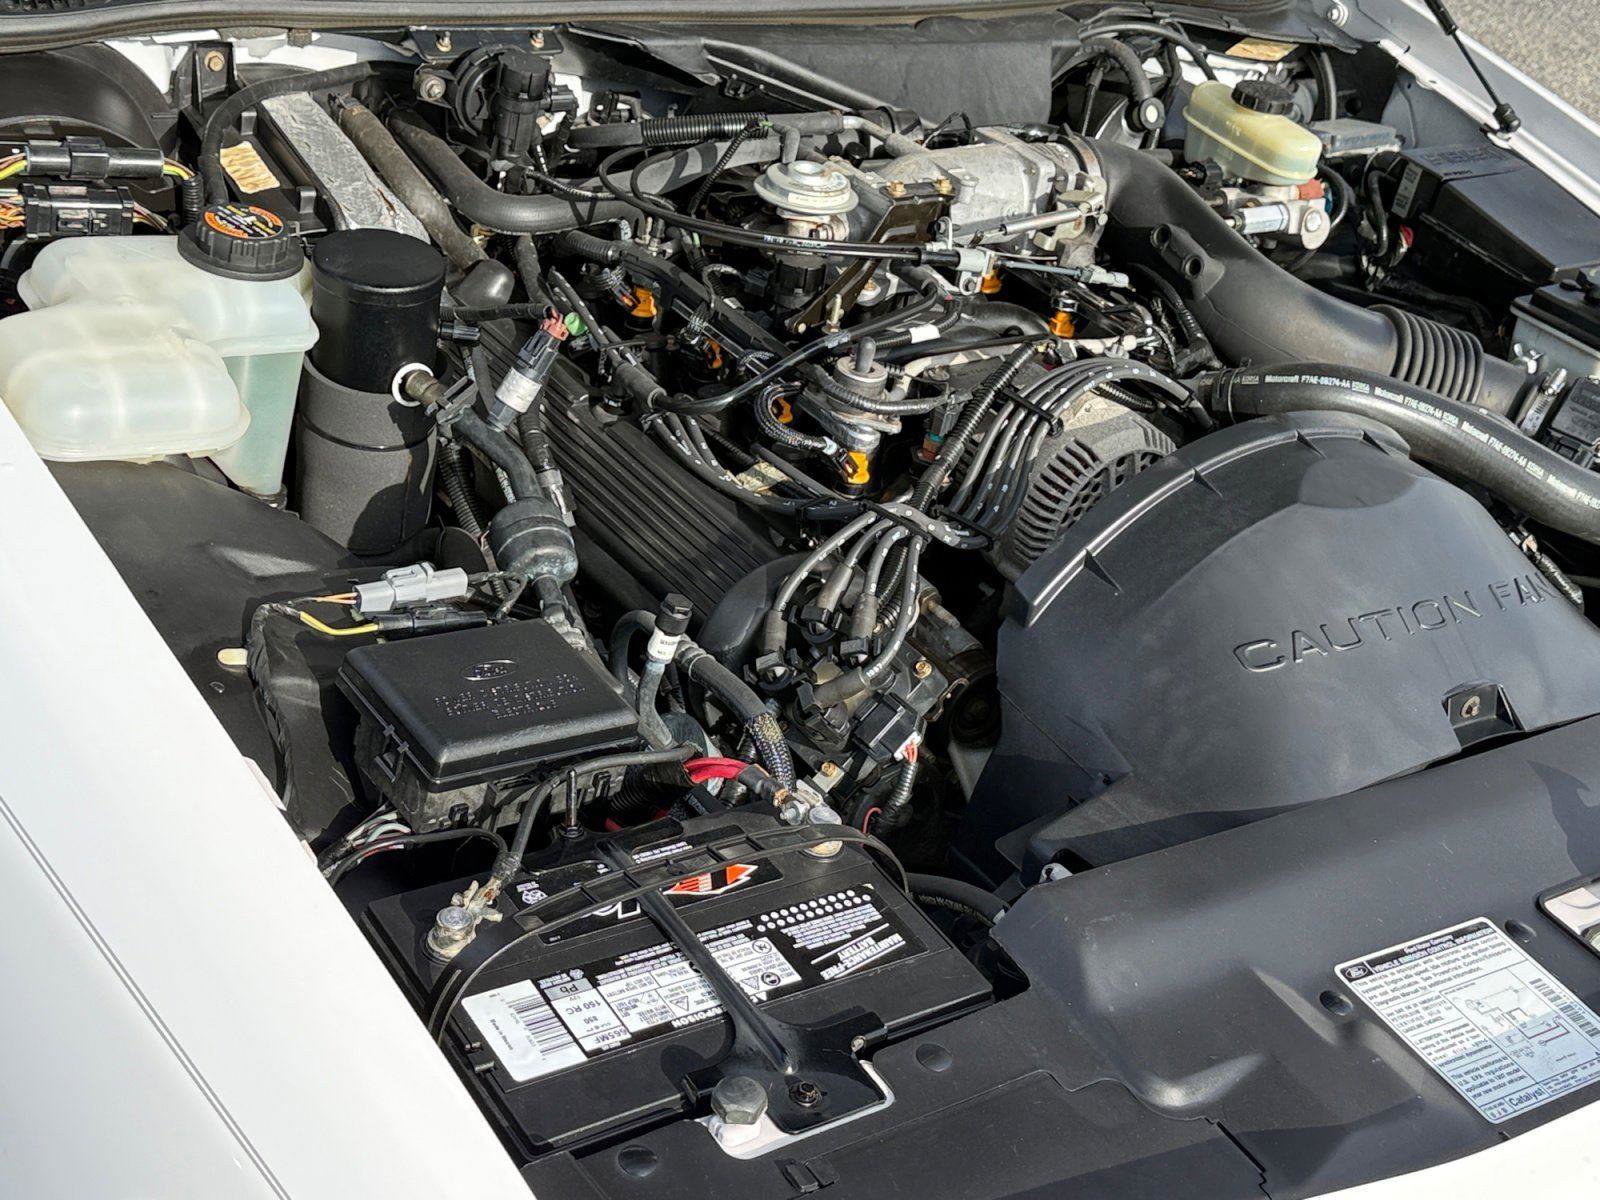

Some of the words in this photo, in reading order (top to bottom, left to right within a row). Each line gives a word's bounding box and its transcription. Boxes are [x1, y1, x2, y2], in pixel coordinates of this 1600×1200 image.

[1233, 590, 1482, 672] CAUTION
[818, 932, 903, 980] MAINTENANCE-FREE
[836, 936, 875, 960] BATTERY
[557, 982, 579, 995] Pb
[562, 1004, 582, 1015] RC
[581, 998, 602, 1009] 150
[1508, 1087, 1547, 1107] Catalyst
